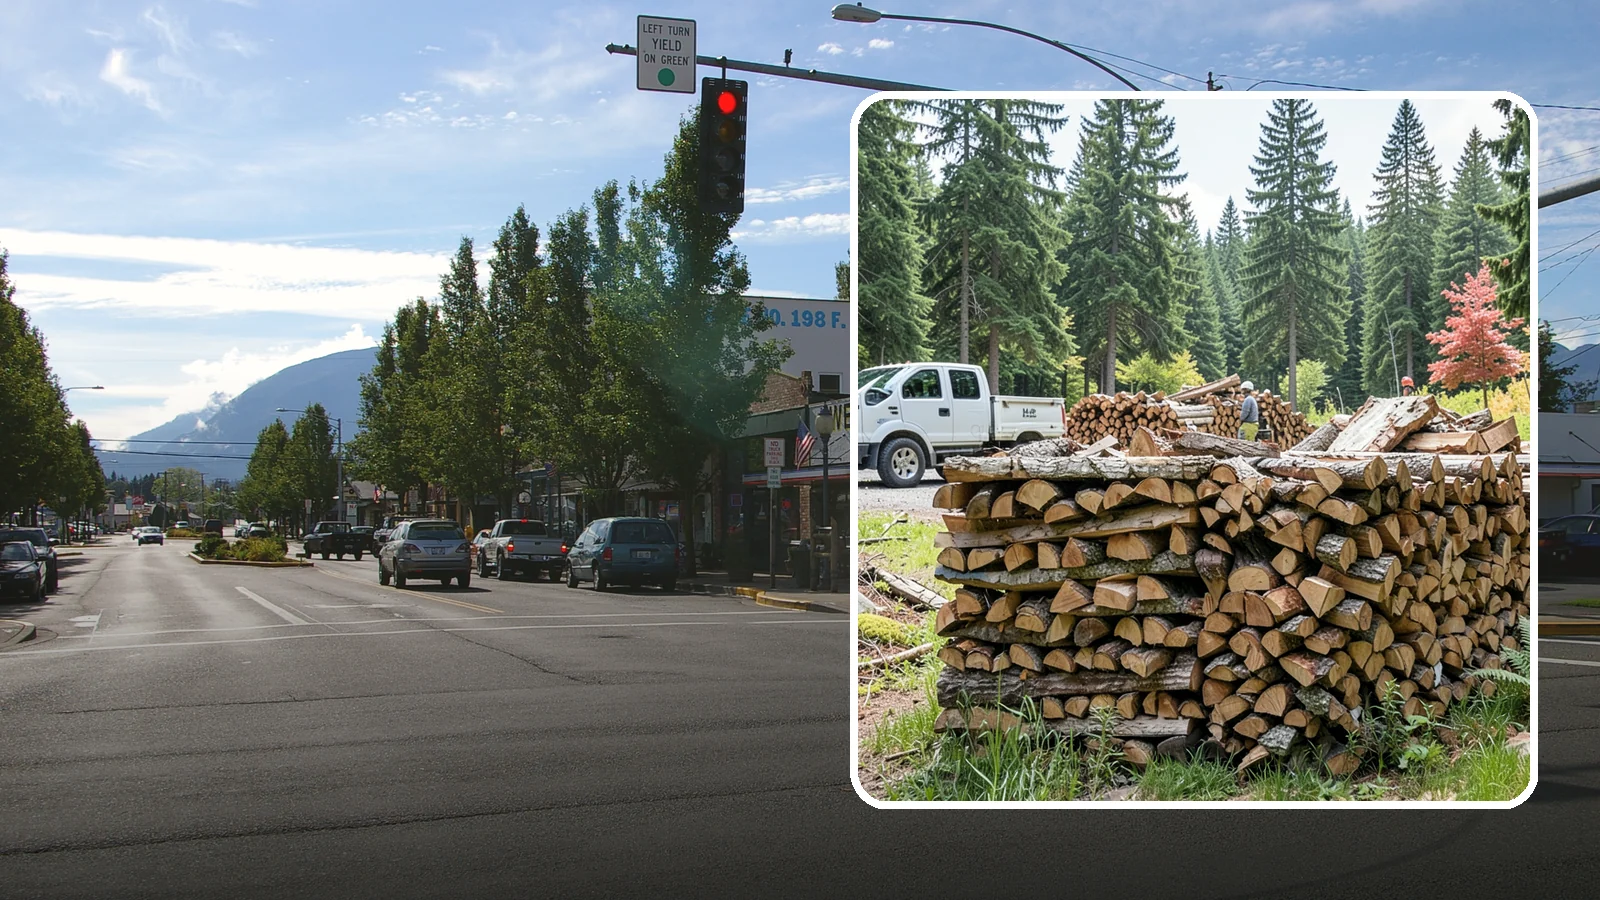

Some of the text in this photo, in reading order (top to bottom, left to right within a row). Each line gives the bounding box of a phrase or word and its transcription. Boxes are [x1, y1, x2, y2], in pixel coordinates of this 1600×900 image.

[643, 24, 690, 36] LEFT TURN
[652, 38, 682, 52] YIELD
[644, 54, 688, 66] ON GREEN
[791, 310, 826, 328] 198
[831, 312, 846, 328] F.
